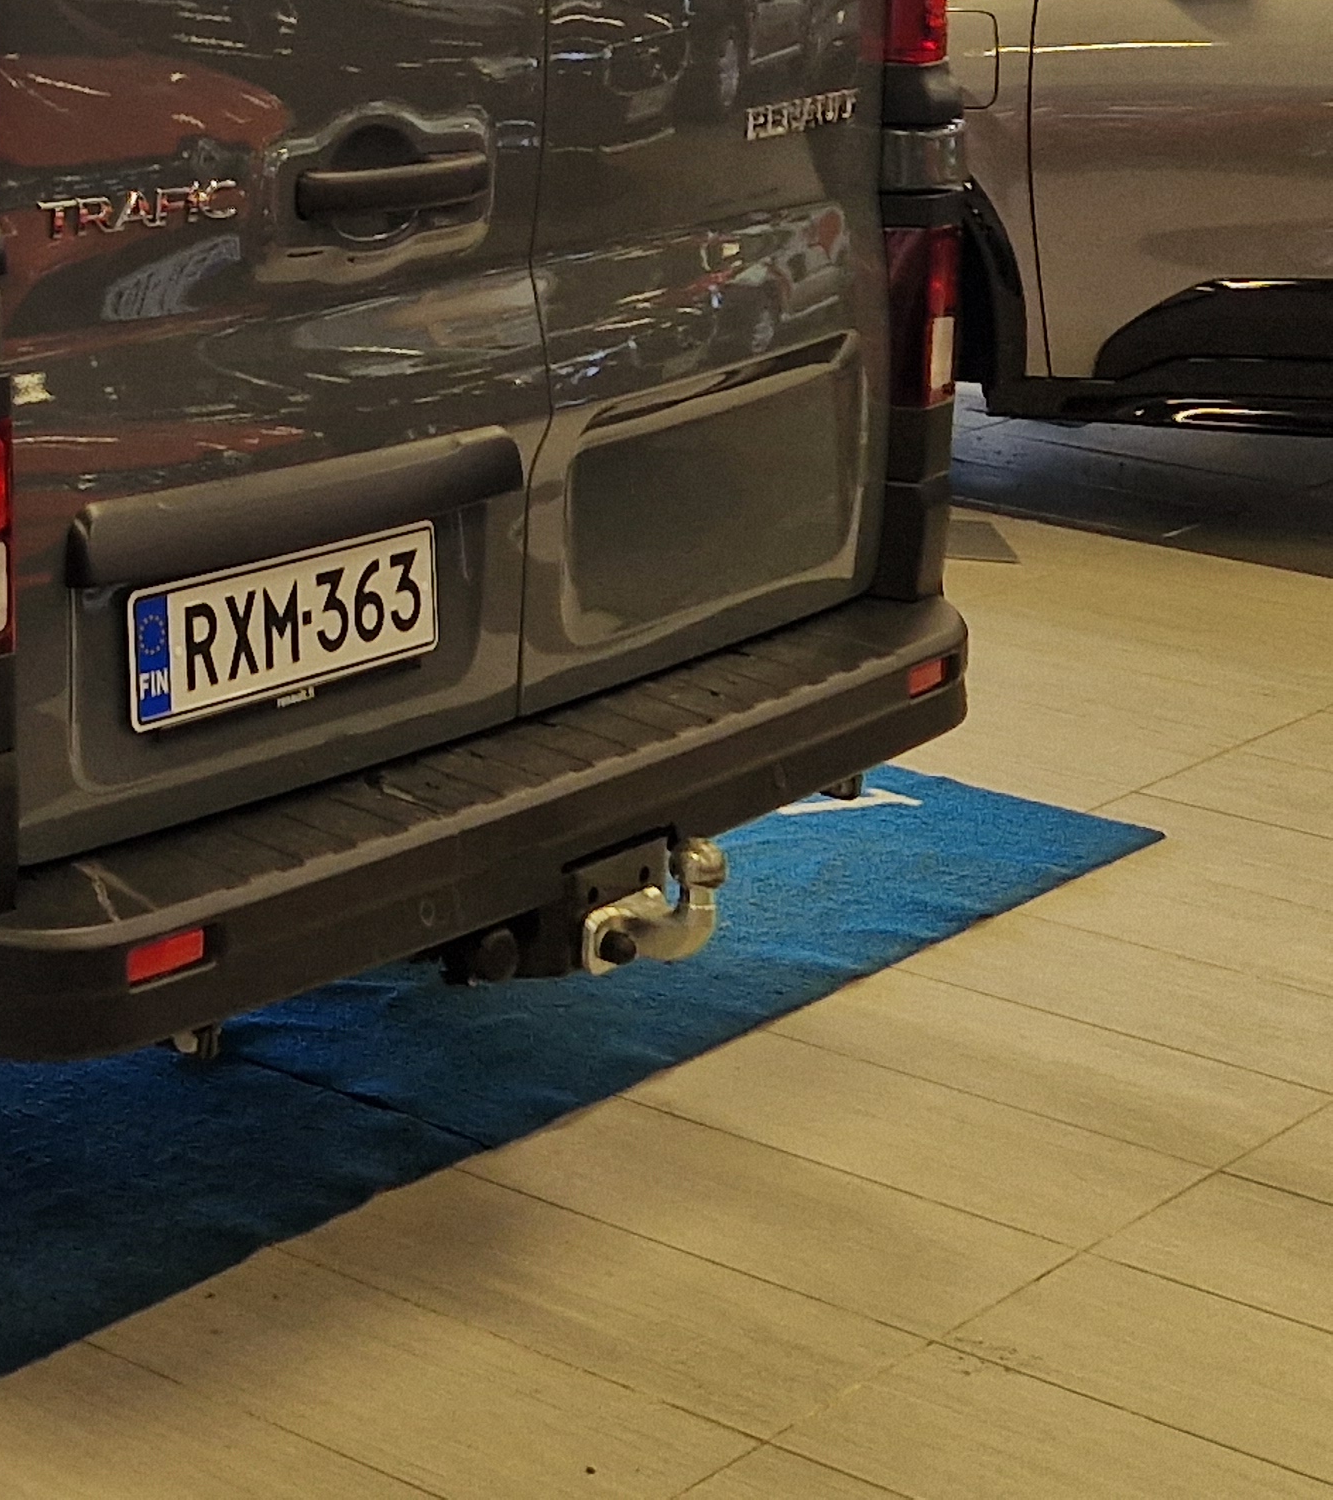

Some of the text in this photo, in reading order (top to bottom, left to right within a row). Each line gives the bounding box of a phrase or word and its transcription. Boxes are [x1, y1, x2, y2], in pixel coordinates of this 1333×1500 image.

[37, 179, 237, 238] TRAFIC
[184, 548, 421, 691] RXM-363
[139, 668, 169, 700] FIN
